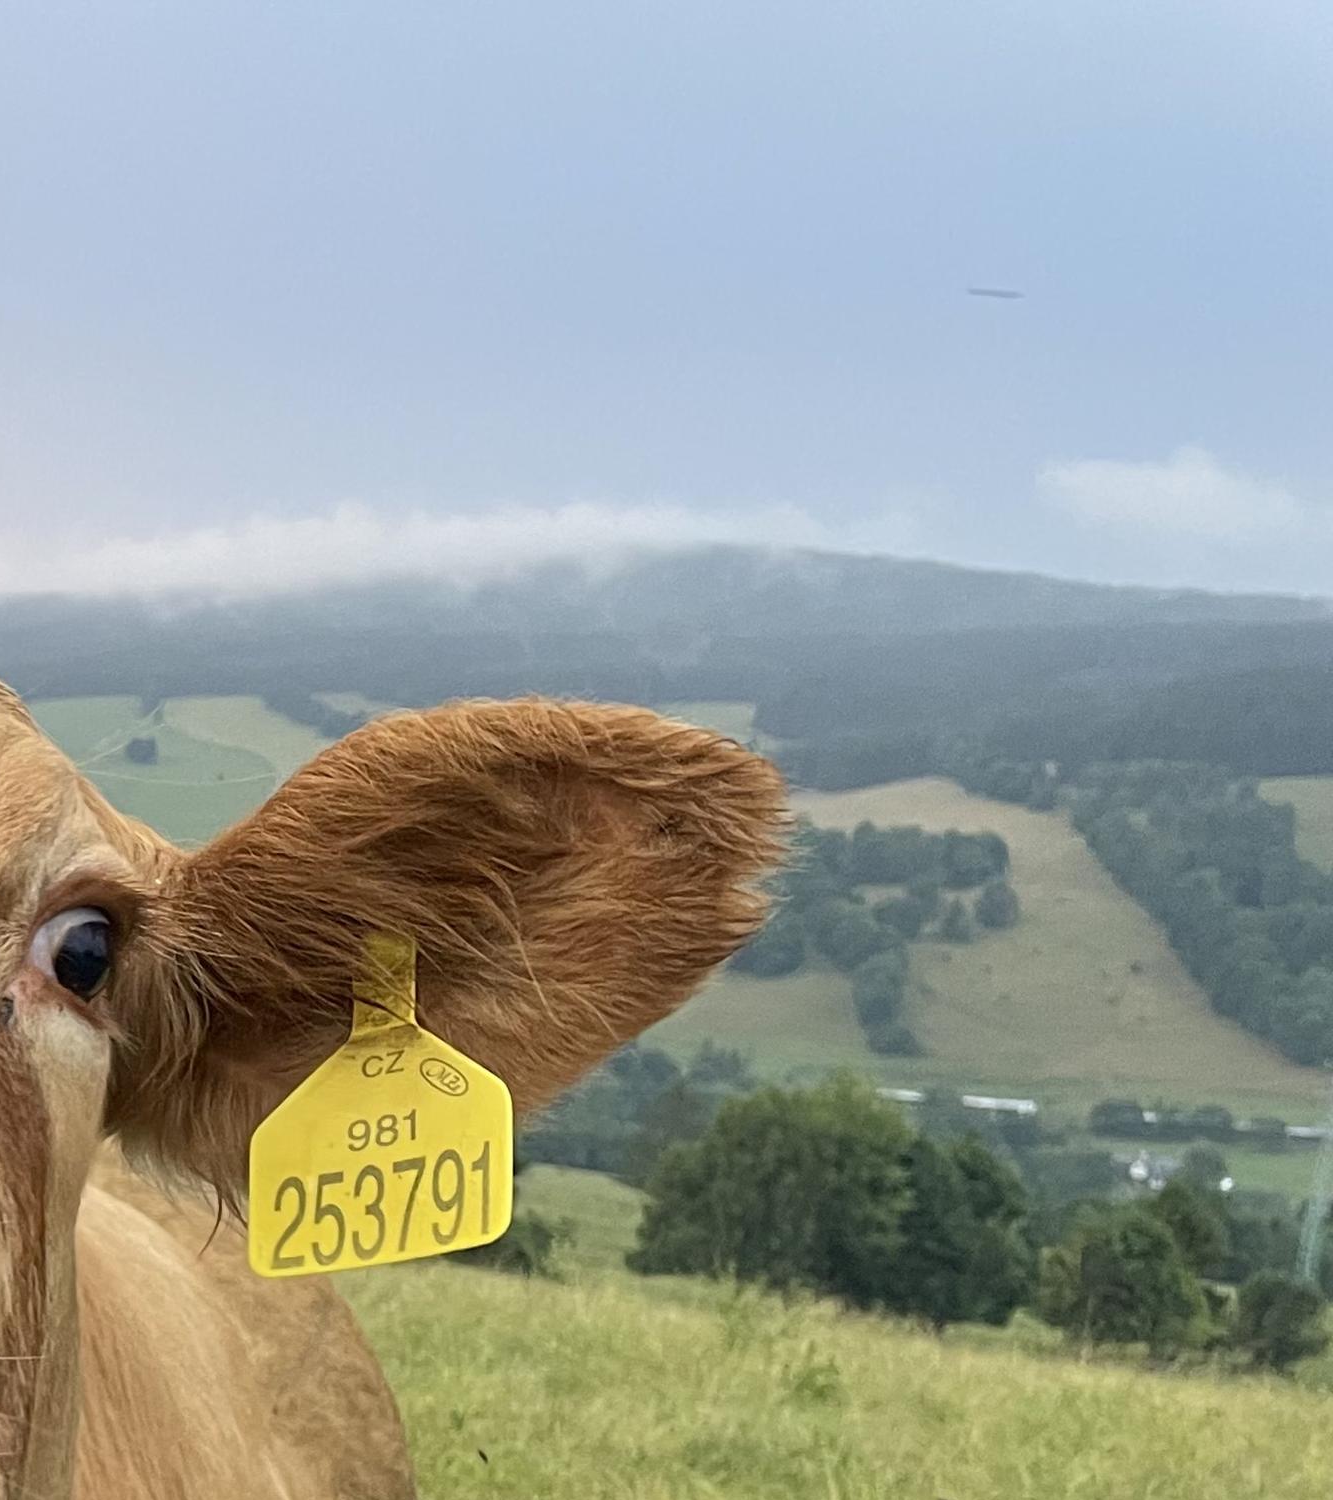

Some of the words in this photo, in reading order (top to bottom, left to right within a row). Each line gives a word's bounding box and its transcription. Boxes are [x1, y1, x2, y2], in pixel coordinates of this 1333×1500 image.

[362, 1051, 405, 1078] CZ
[347, 1109, 417, 1151] 981
[271, 1140, 491, 1270] 253791
